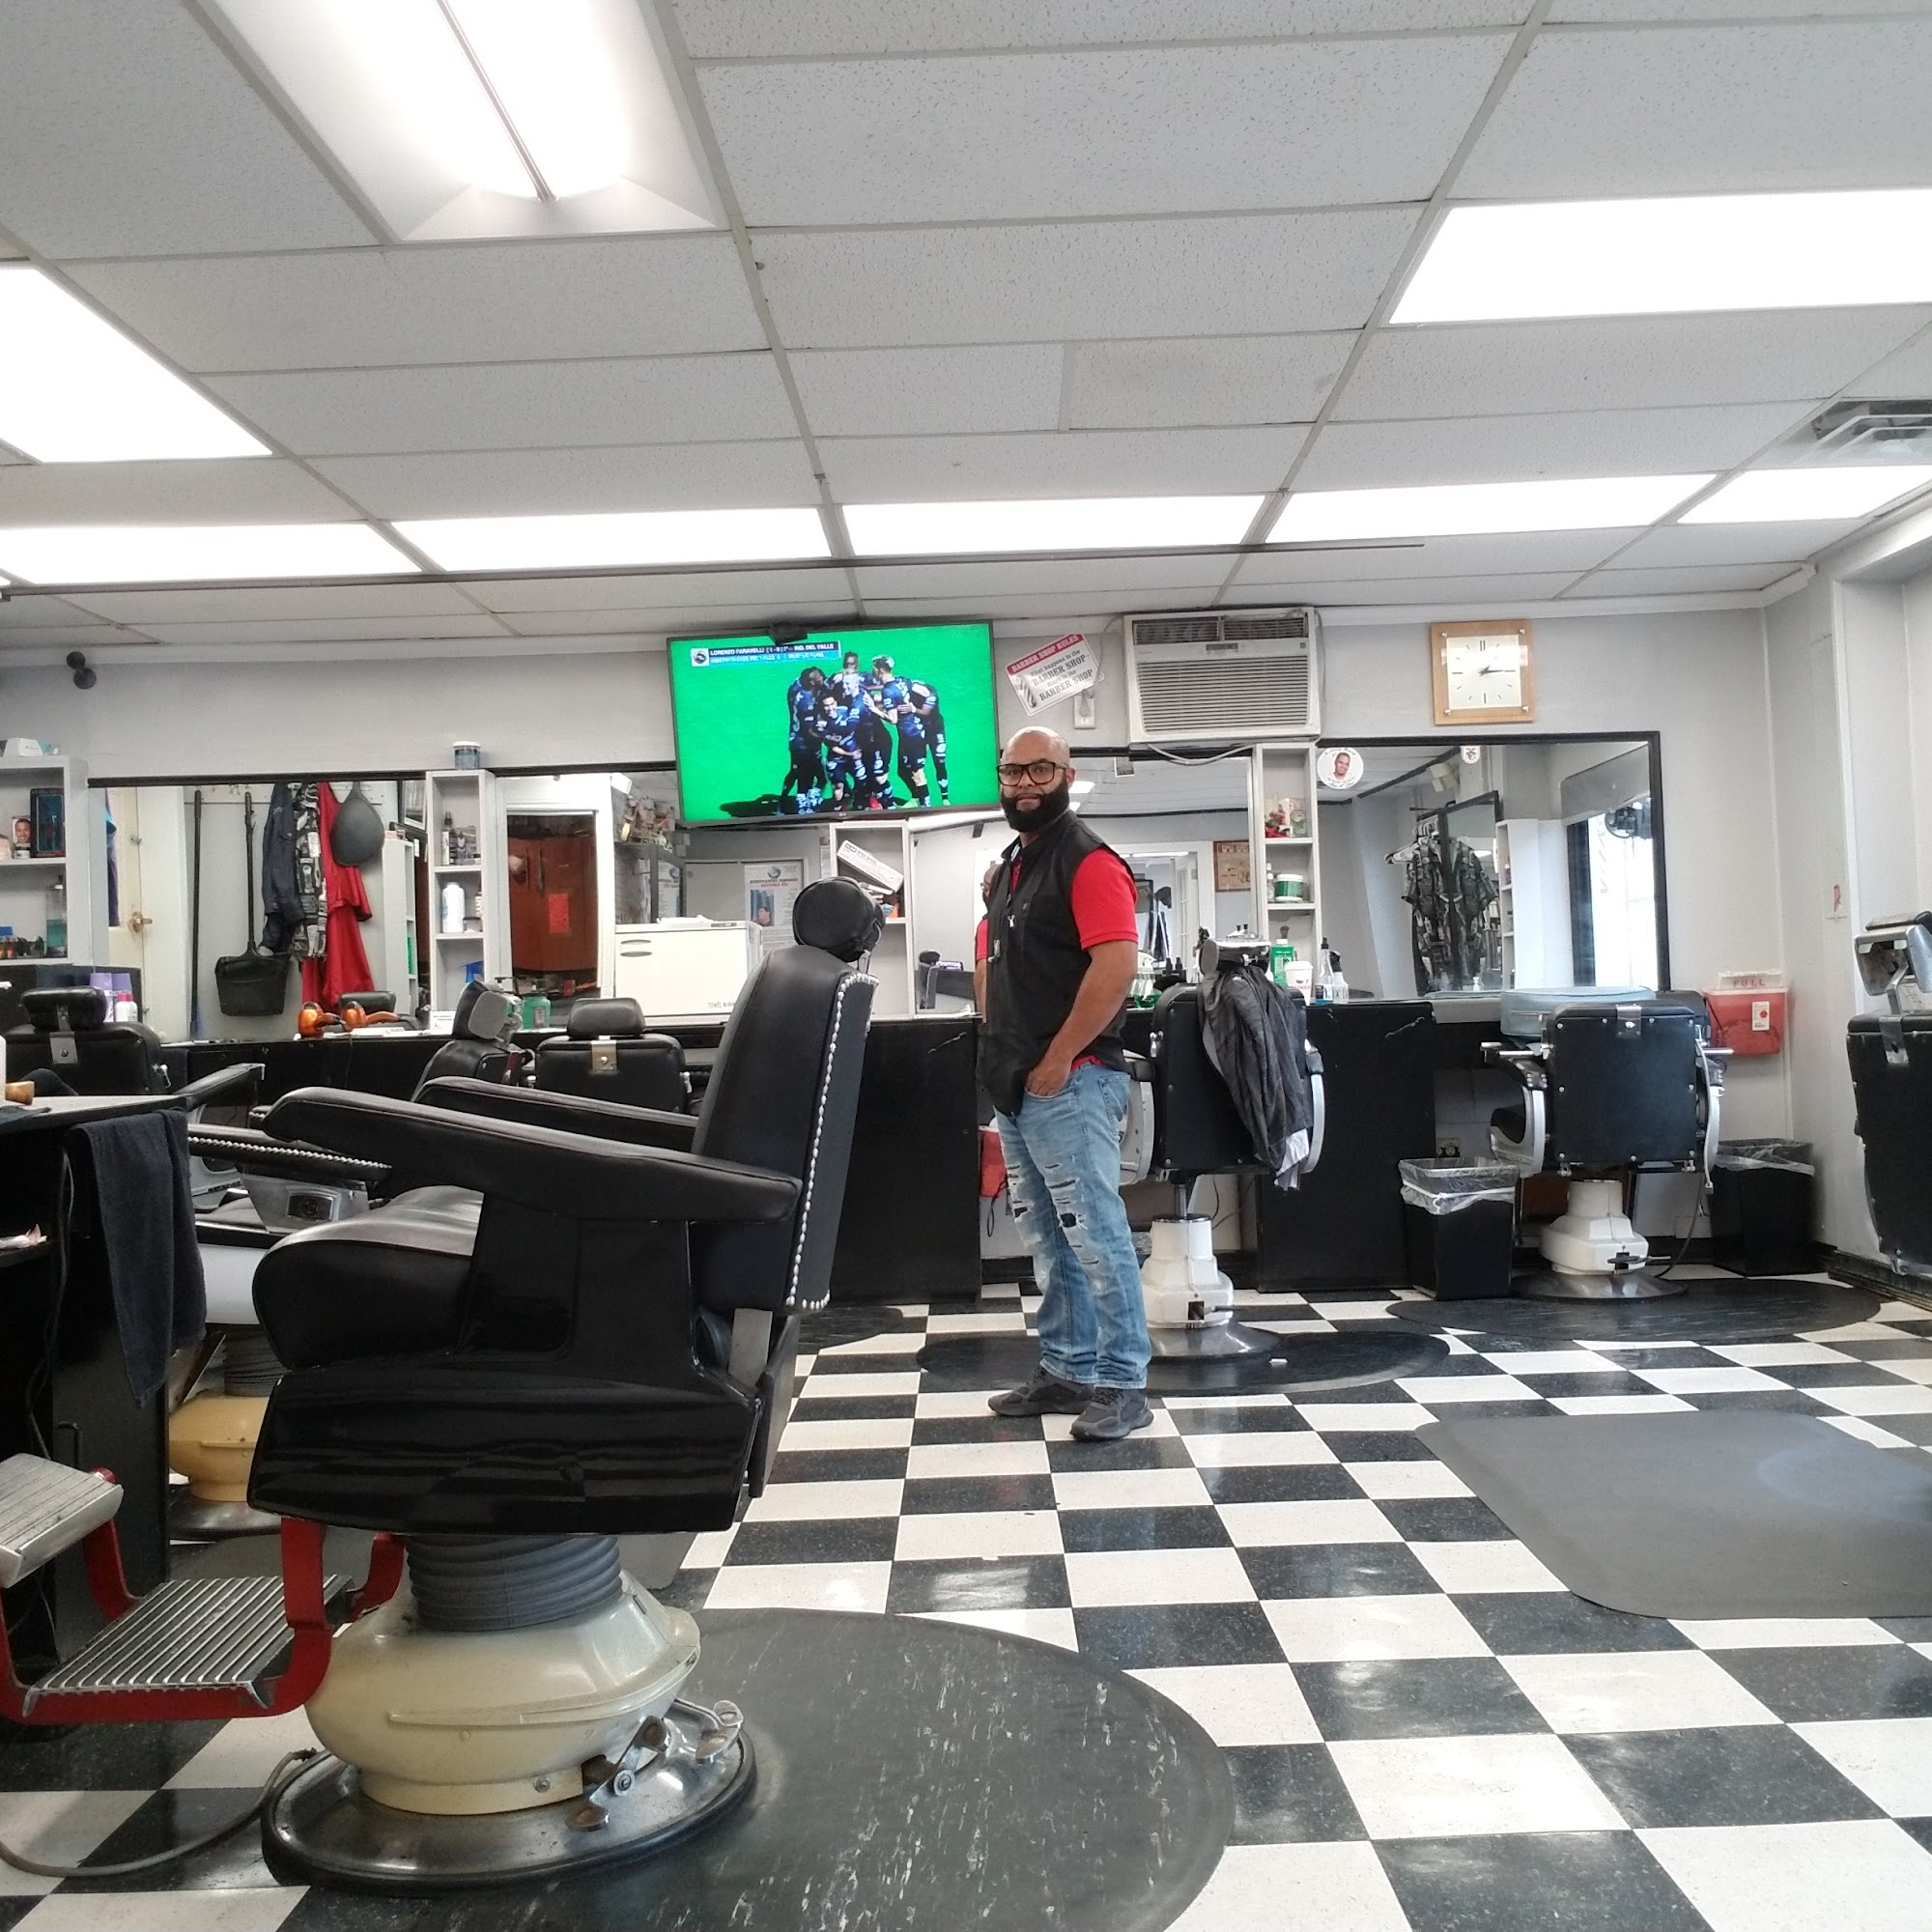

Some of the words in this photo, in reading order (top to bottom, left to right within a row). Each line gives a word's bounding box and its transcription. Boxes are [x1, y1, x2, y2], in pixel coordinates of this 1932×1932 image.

[1011, 655, 1038, 672] BARBER
[1038, 645, 1056, 659] SHOP
[1056, 635, 1079, 649] RULES
[1033, 666, 1065, 686] BARBER
[1065, 654, 1086, 669] SHOP
[1038, 680, 1072, 701] BARBER
[1072, 668, 1094, 684] SHOP
